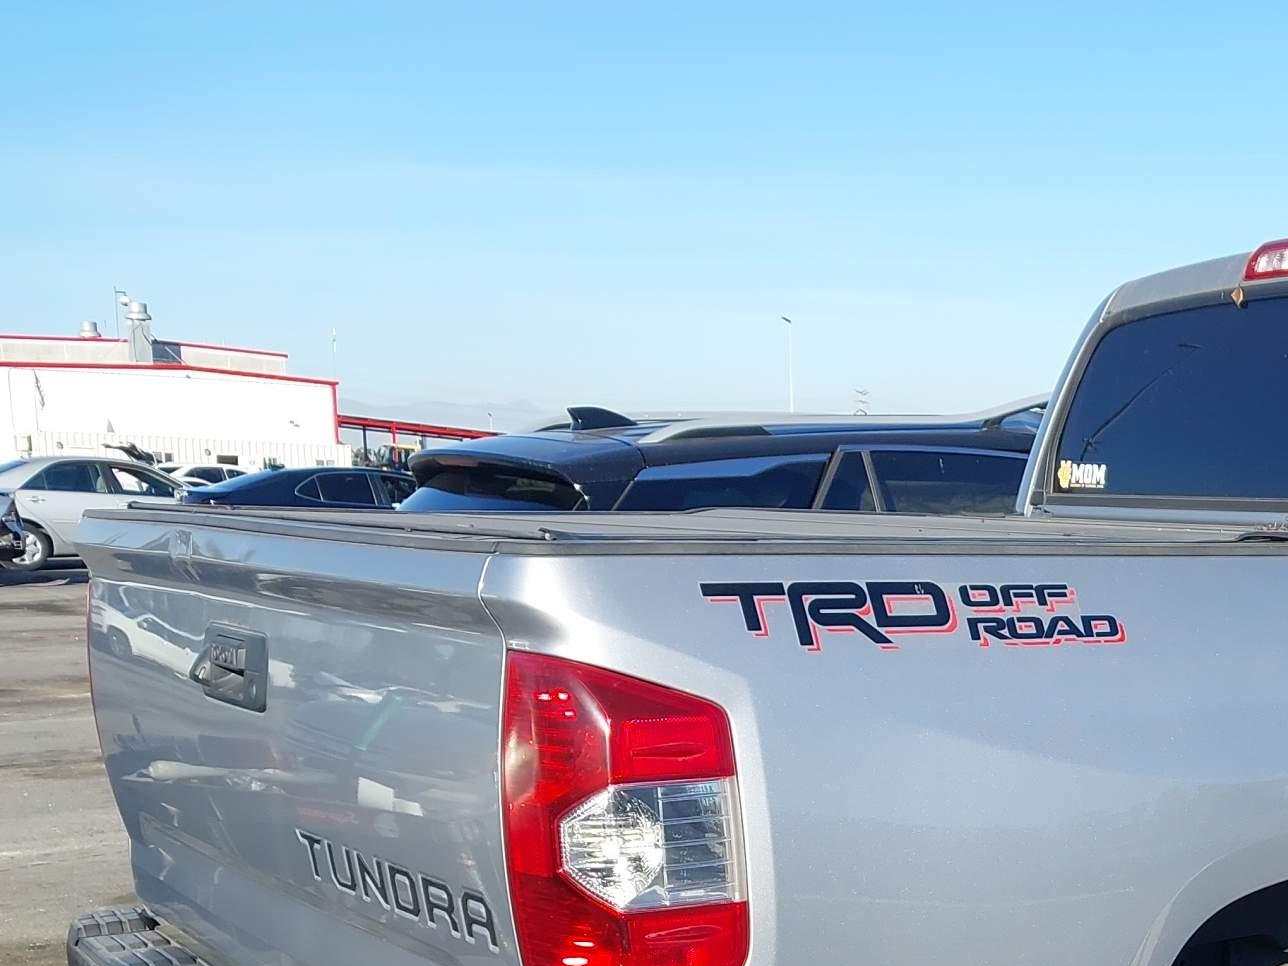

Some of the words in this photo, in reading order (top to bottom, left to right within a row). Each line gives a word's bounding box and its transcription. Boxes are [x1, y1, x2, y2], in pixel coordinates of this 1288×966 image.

[1071, 463, 1107, 484] MOM
[698, 580, 958, 653] TRD
[957, 583, 1077, 613] OFF
[966, 614, 1128, 648] ROAD
[295, 828, 500, 955] TUNDRA
